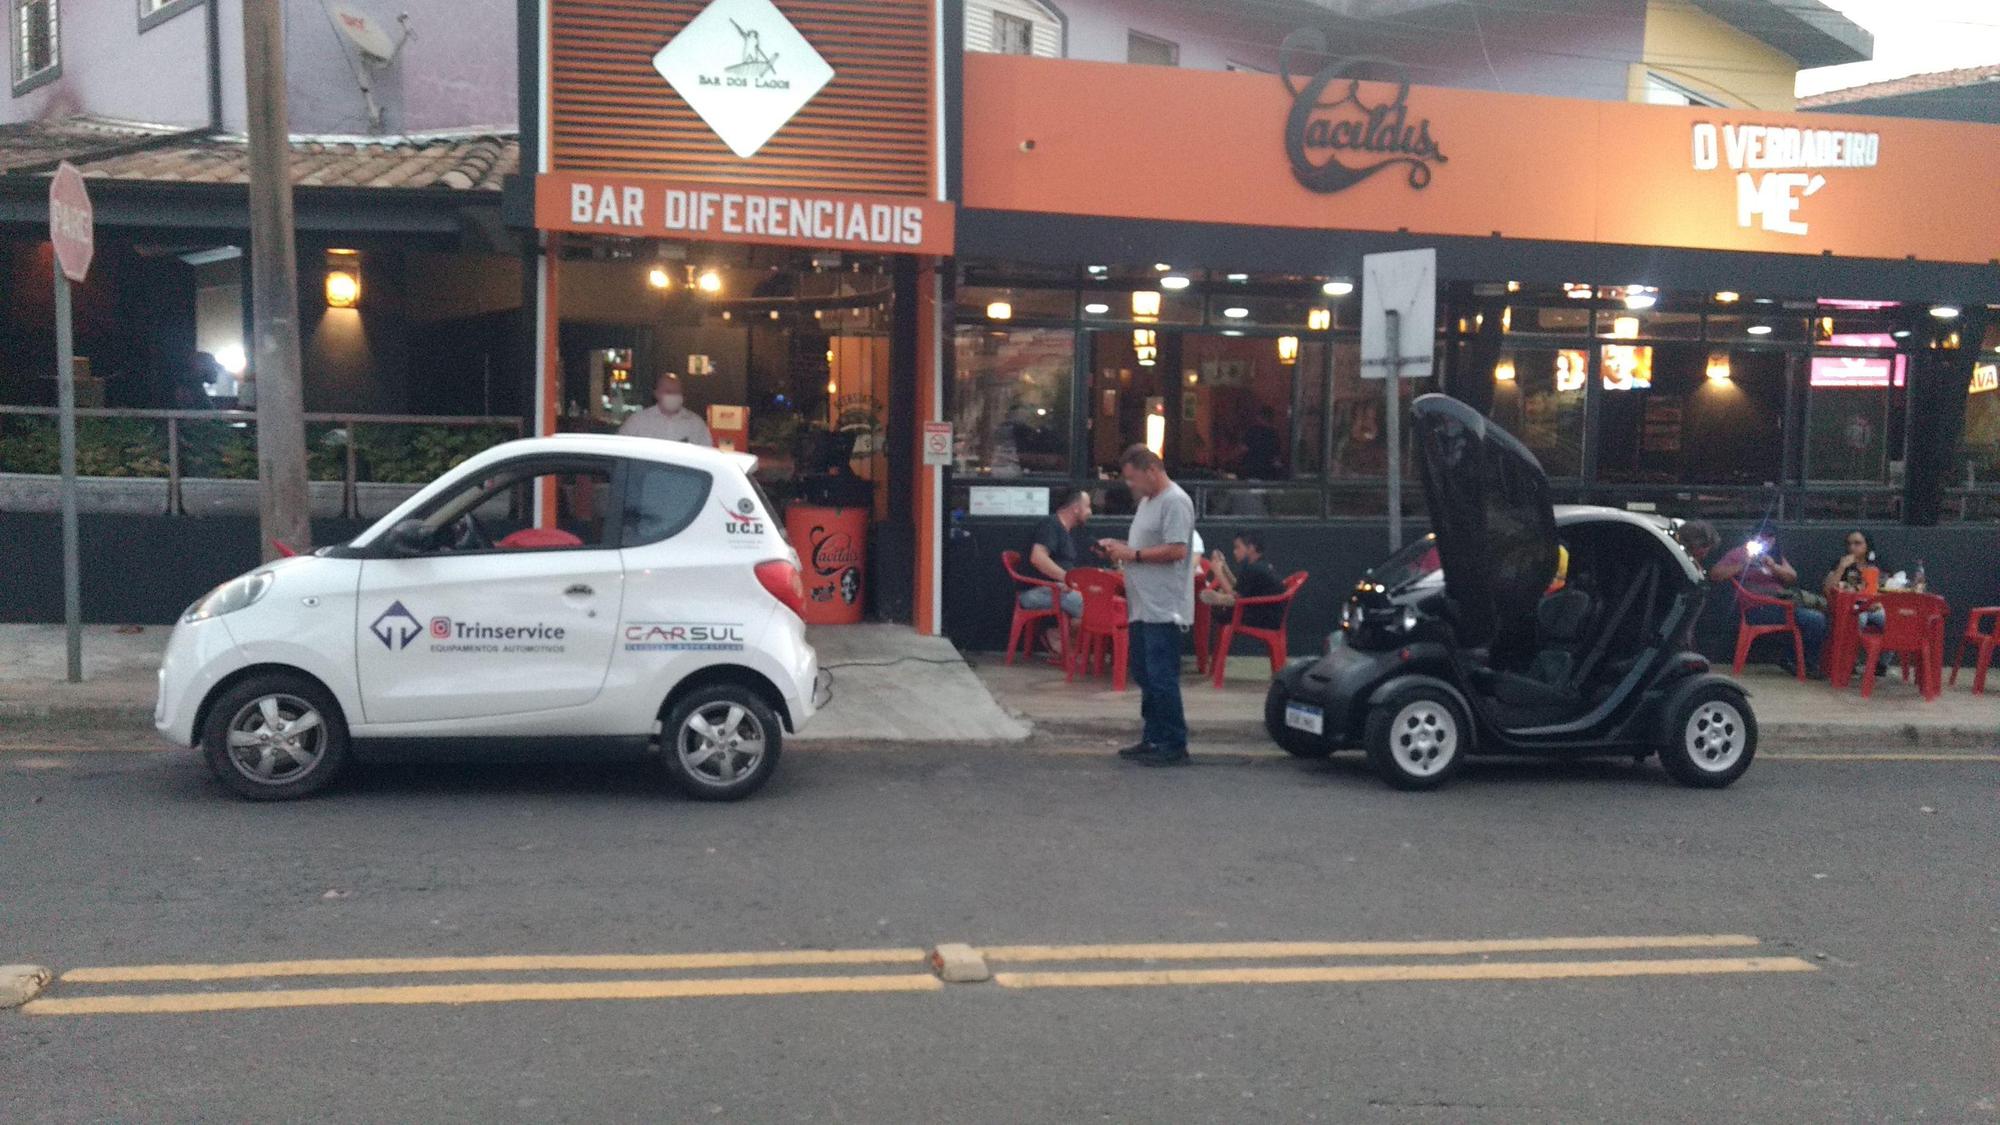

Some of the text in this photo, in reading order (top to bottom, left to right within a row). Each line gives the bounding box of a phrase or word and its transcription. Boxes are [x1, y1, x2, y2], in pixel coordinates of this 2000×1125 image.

[699, 74, 721, 86] BAR
[726, 77, 747, 87] DOS
[1692, 122, 1880, 170] O VERDADEIRO
[52, 199, 92, 243] PARE
[570, 182, 924, 245] BAR DIFERENCIADIS
[455, 621, 566, 640] Trinservice
[625, 626, 743, 641] CARSUL
[430, 644, 566, 654] EQUIPAMENTOS AUTOMOTIVOS
